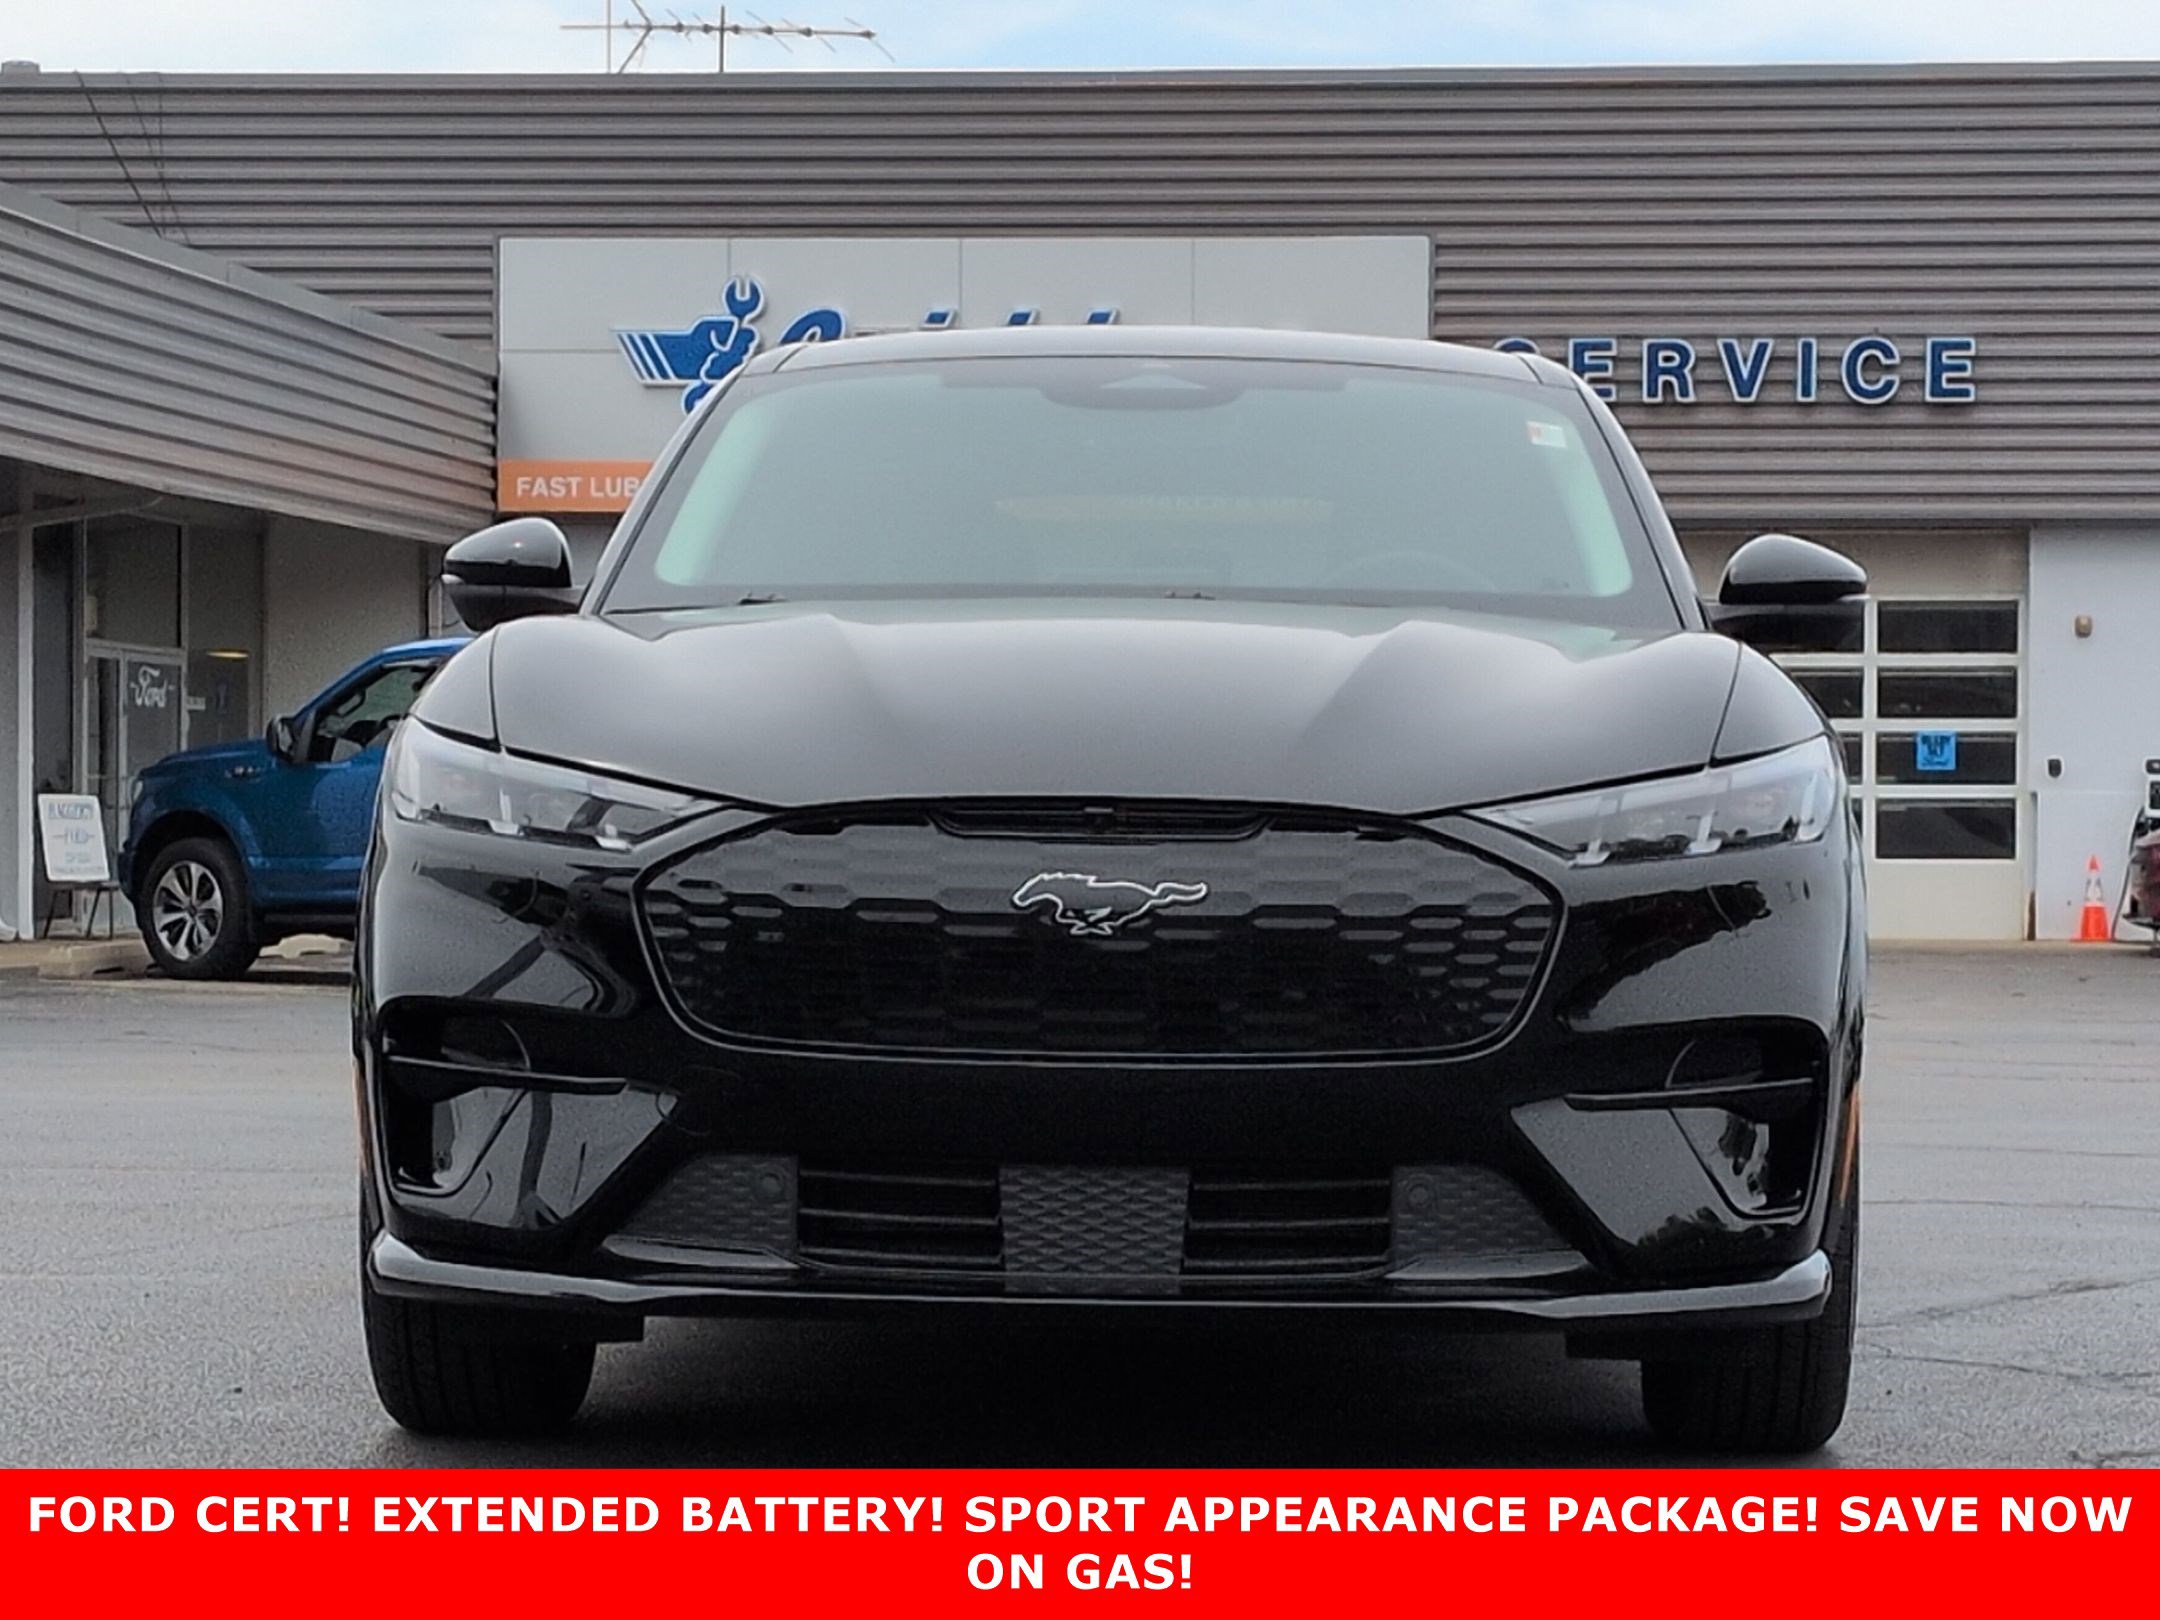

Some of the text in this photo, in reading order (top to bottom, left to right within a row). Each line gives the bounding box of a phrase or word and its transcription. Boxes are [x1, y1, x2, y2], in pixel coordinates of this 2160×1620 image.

[1494, 336, 1978, 405] ERVICE
[516, 476, 640, 498] FAST LUB
[130, 665, 175, 708] Ford
